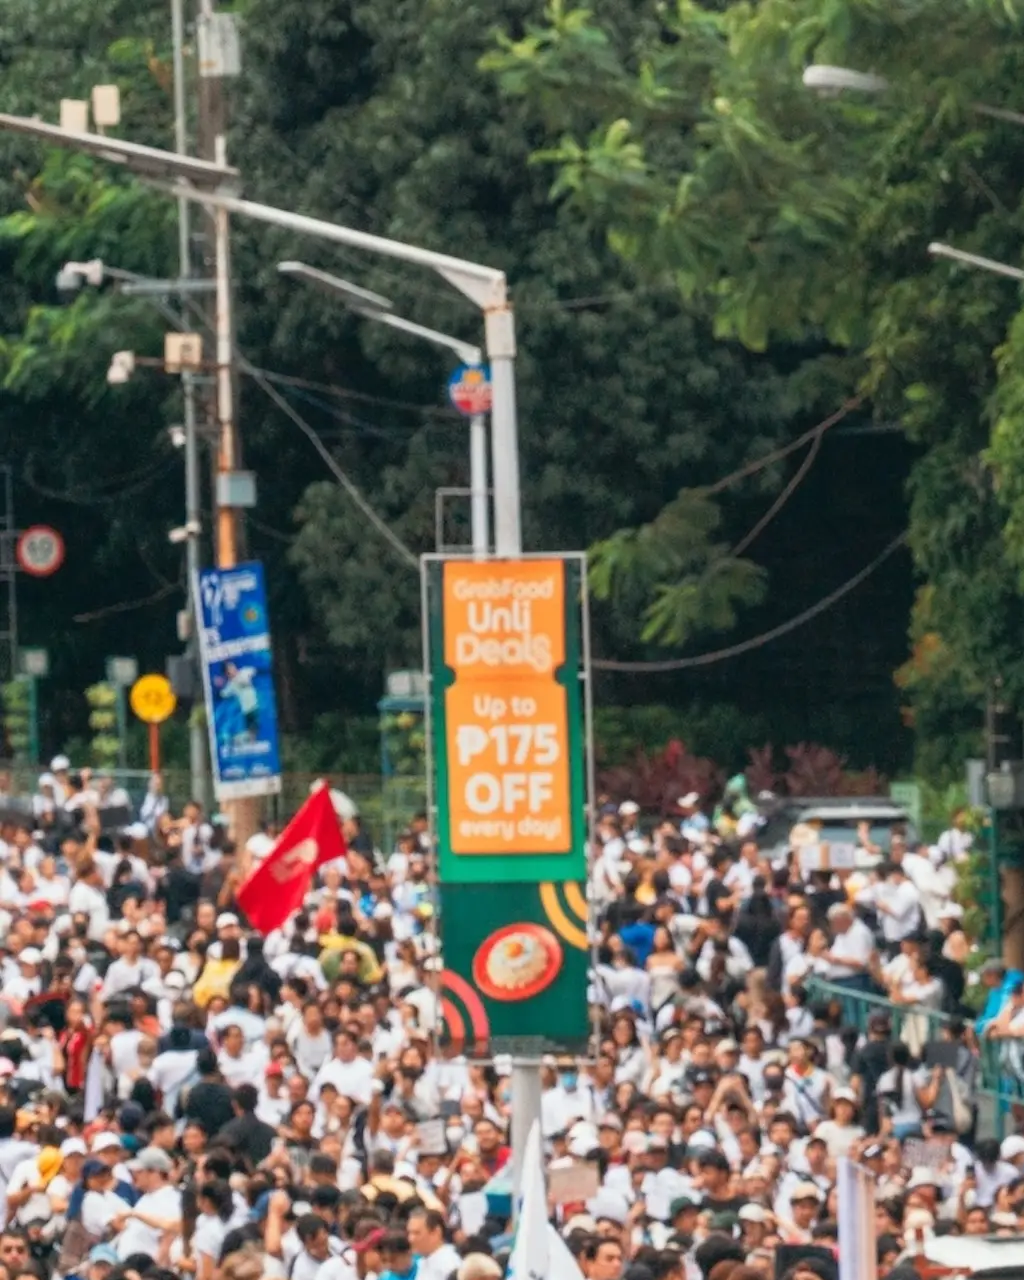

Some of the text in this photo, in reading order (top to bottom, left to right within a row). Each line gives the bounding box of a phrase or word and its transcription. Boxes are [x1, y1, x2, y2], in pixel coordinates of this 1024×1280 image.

[453, 578, 554, 600] GrabFood
[467, 601, 531, 633] Unli
[455, 632, 553, 673] Deals
[473, 694, 537, 720] Up to
[464, 771, 554, 814] OFF
[459, 815, 562, 842] every day!
